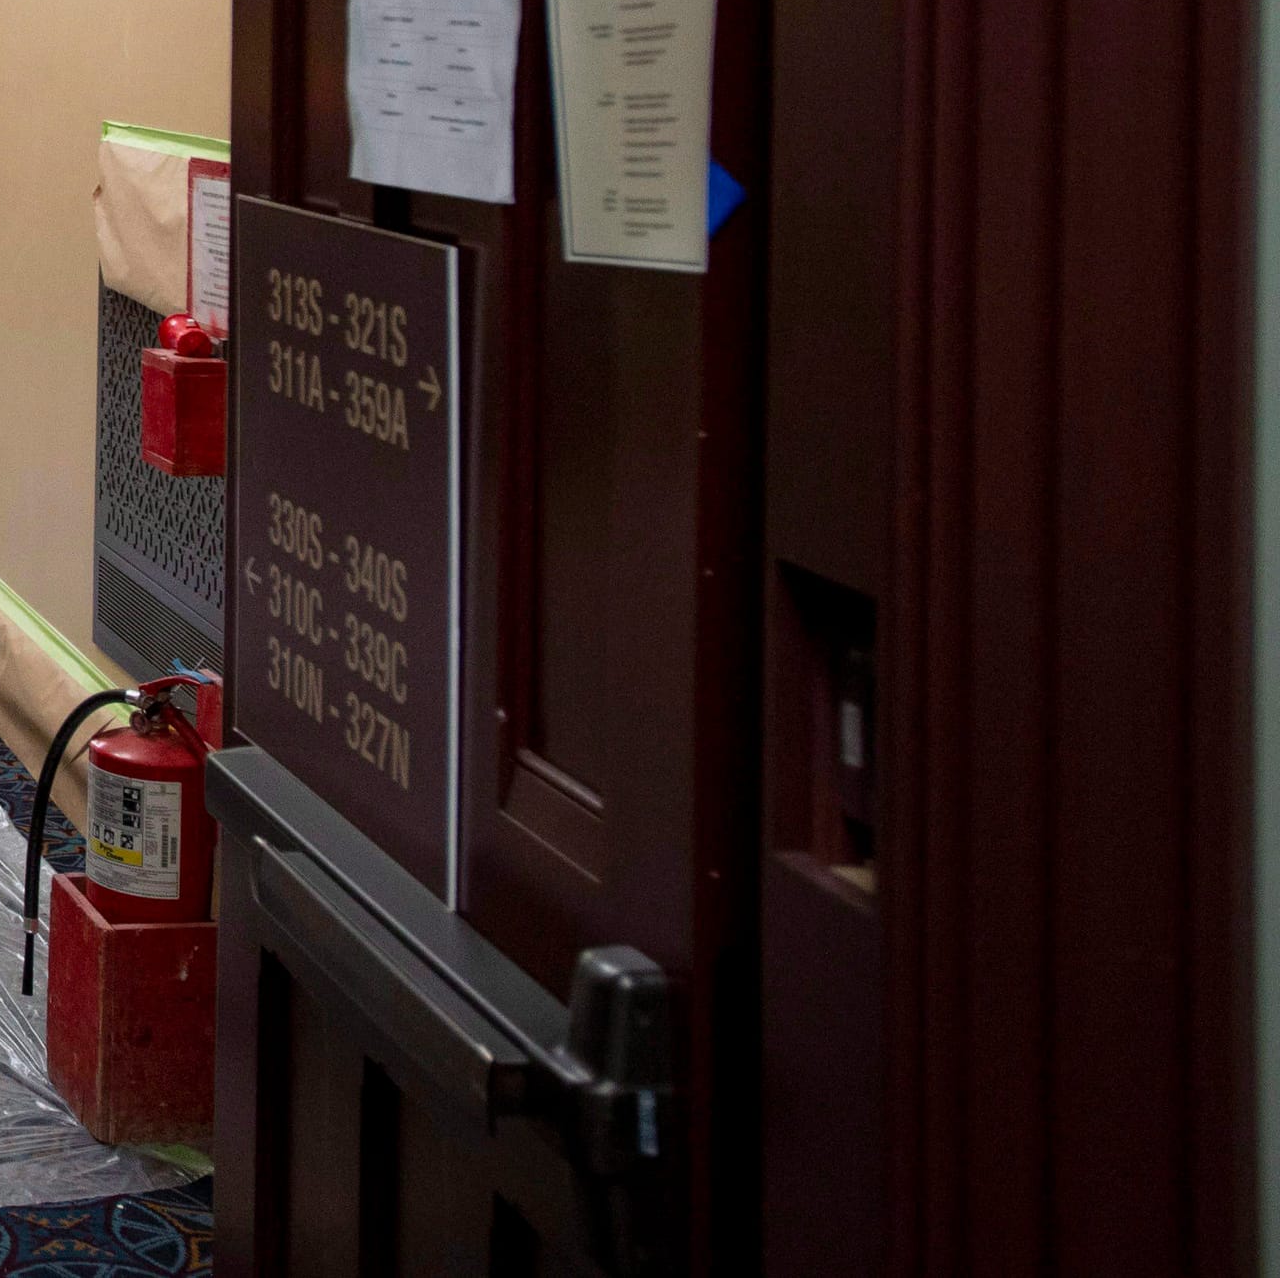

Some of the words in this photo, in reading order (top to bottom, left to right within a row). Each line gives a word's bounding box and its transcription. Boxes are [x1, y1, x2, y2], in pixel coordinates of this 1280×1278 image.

[269, 268, 323, 336] 313S
[345, 292, 408, 367] 321S
[269, 340, 325, 413] 311A
[345, 371, 410, 451] 359A
[269, 493, 323, 570] 330S
[345, 535, 408, 622] 340S
[269, 563, 323, 646] 310C
[345, 612, 408, 704] 339C
[269, 636, 323, 723] 310N
[345, 691, 410, 791] 327N
